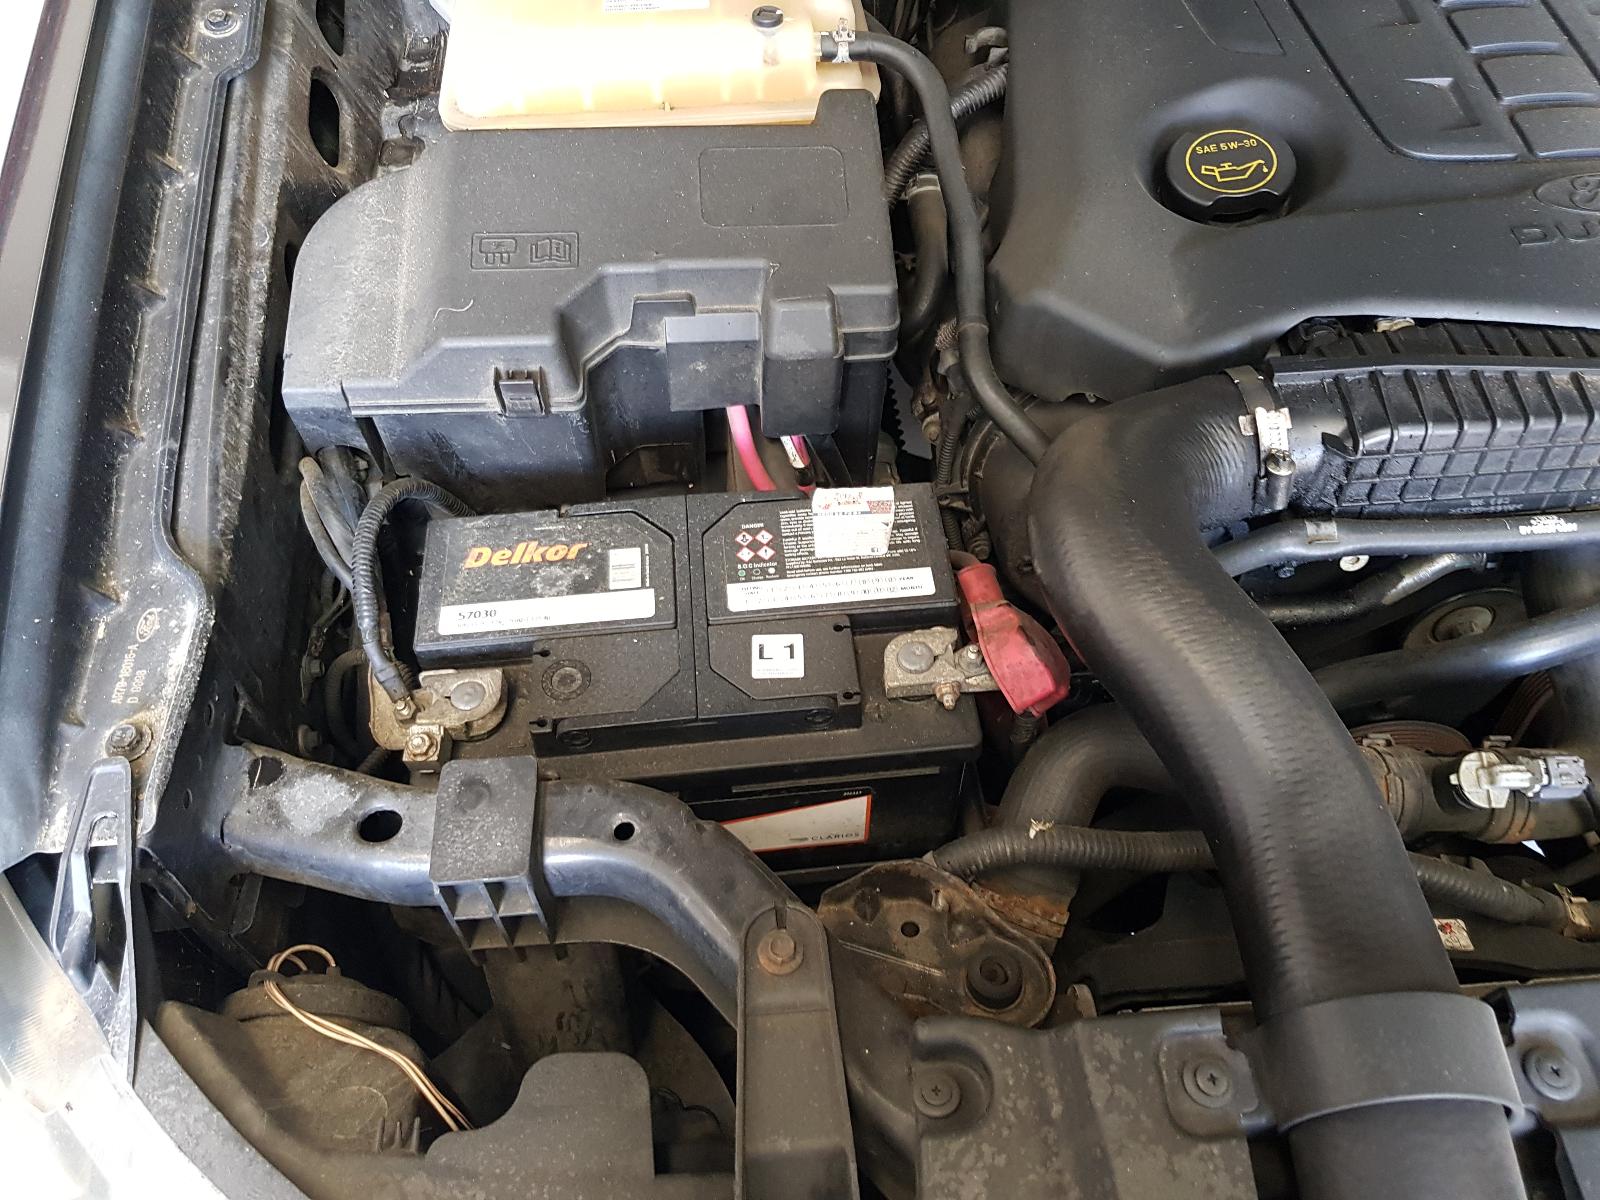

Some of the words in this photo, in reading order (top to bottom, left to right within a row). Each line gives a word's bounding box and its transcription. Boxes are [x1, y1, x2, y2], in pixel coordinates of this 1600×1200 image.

[1195, 144, 1218, 155] SAE
[1220, 139, 1258, 151] 5W-30
[1510, 221, 1600, 247] DU
[463, 539, 589, 571] Delkor
[457, 609, 498, 621] 57030
